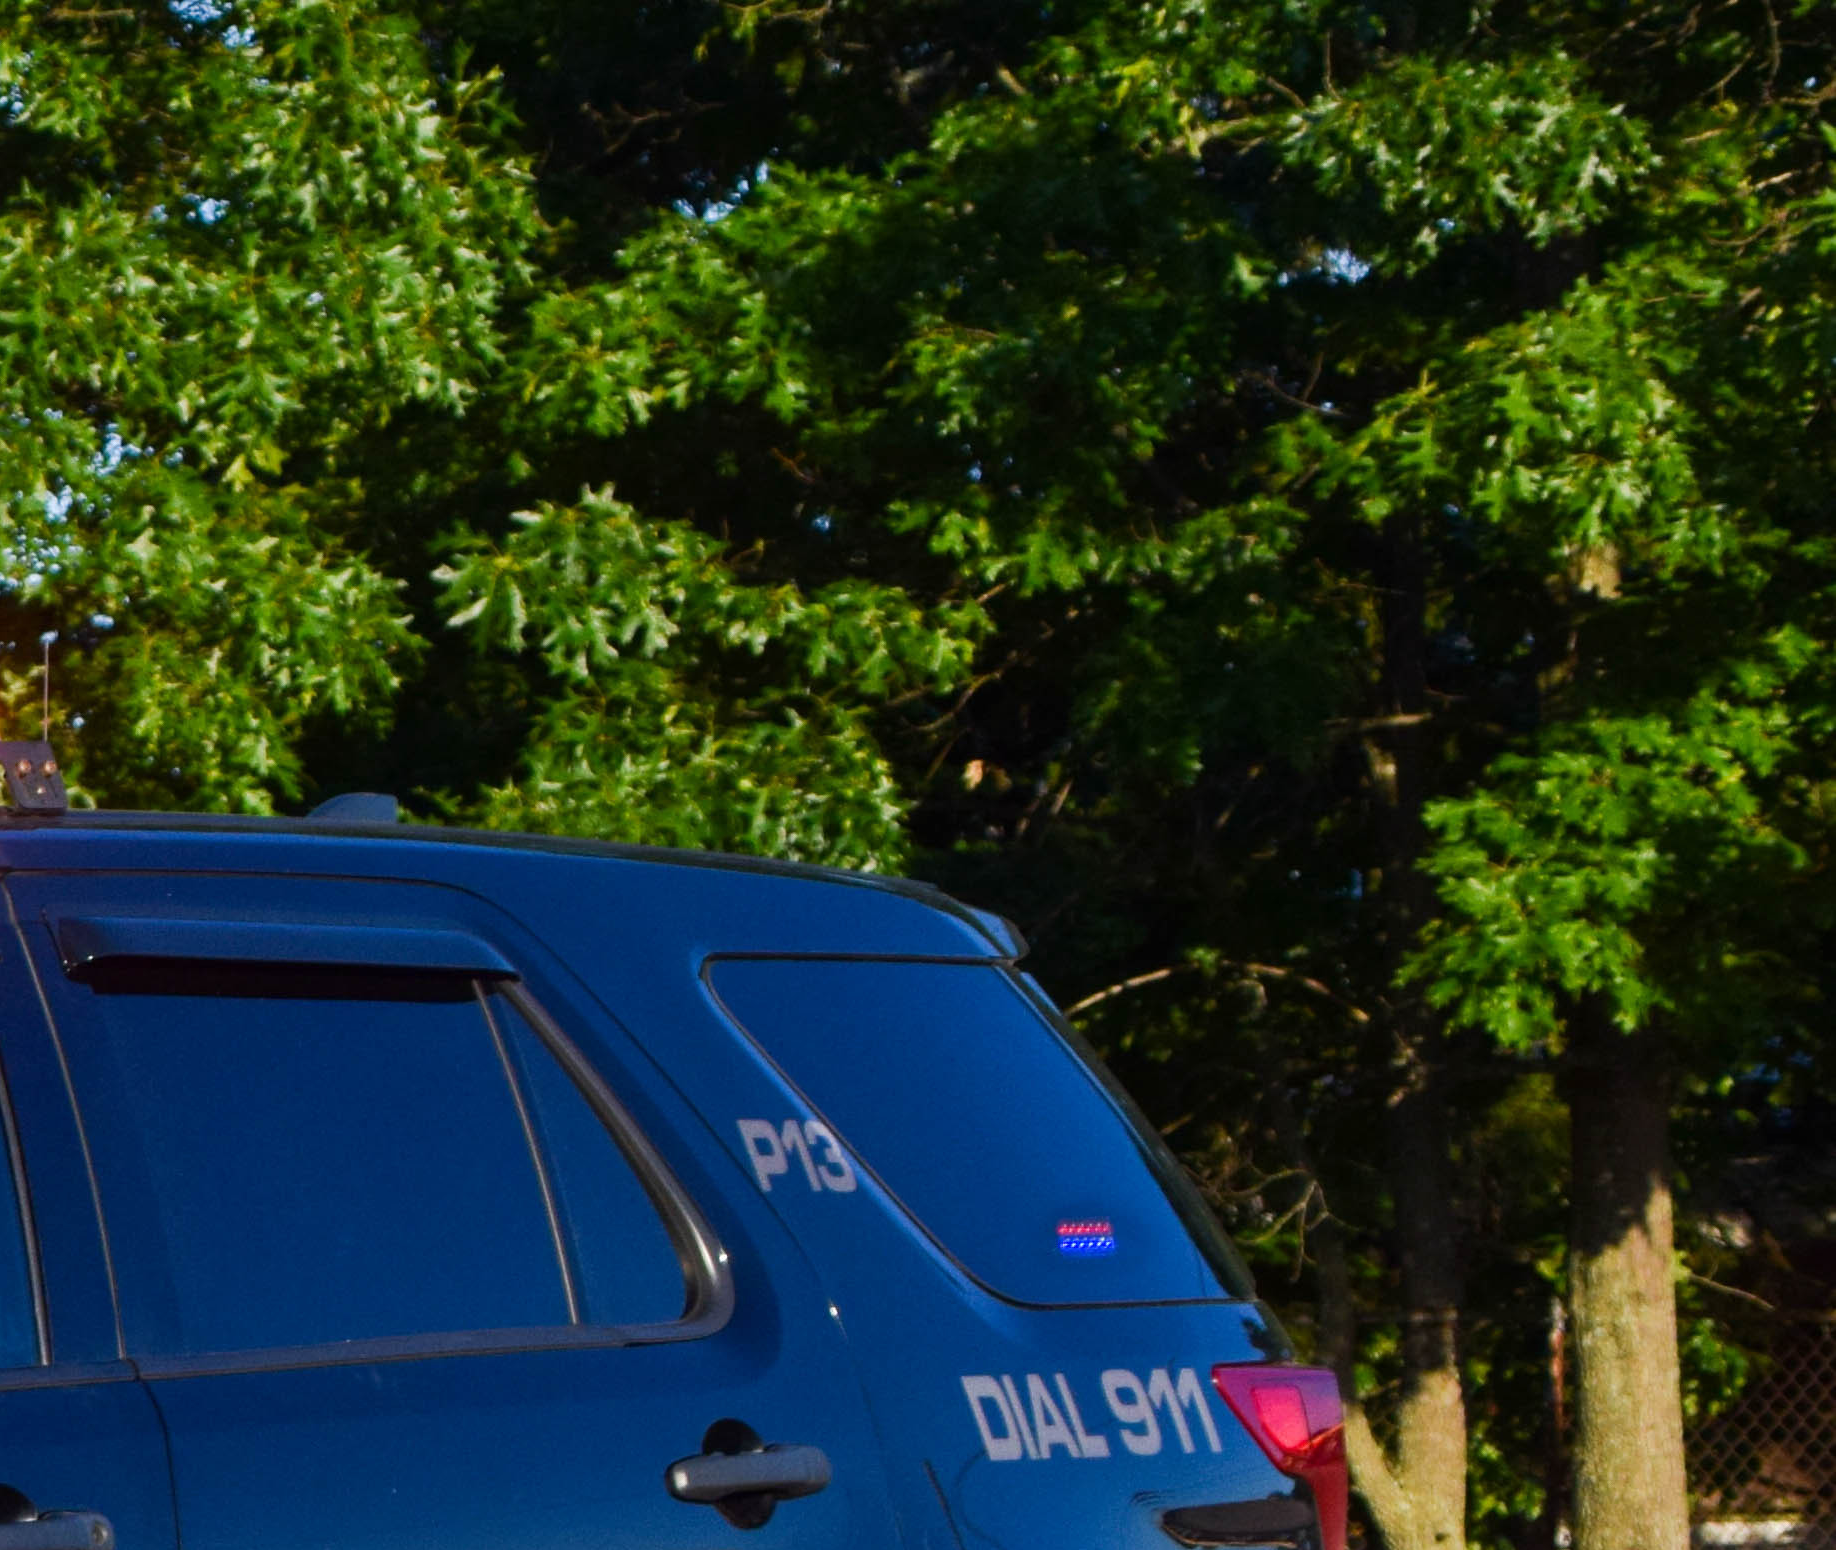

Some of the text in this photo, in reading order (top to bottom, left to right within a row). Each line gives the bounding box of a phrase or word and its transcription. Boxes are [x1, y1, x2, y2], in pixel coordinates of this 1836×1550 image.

[737, 1119, 858, 1193] P13
[960, 1367, 1223, 1462] DIAL 911
